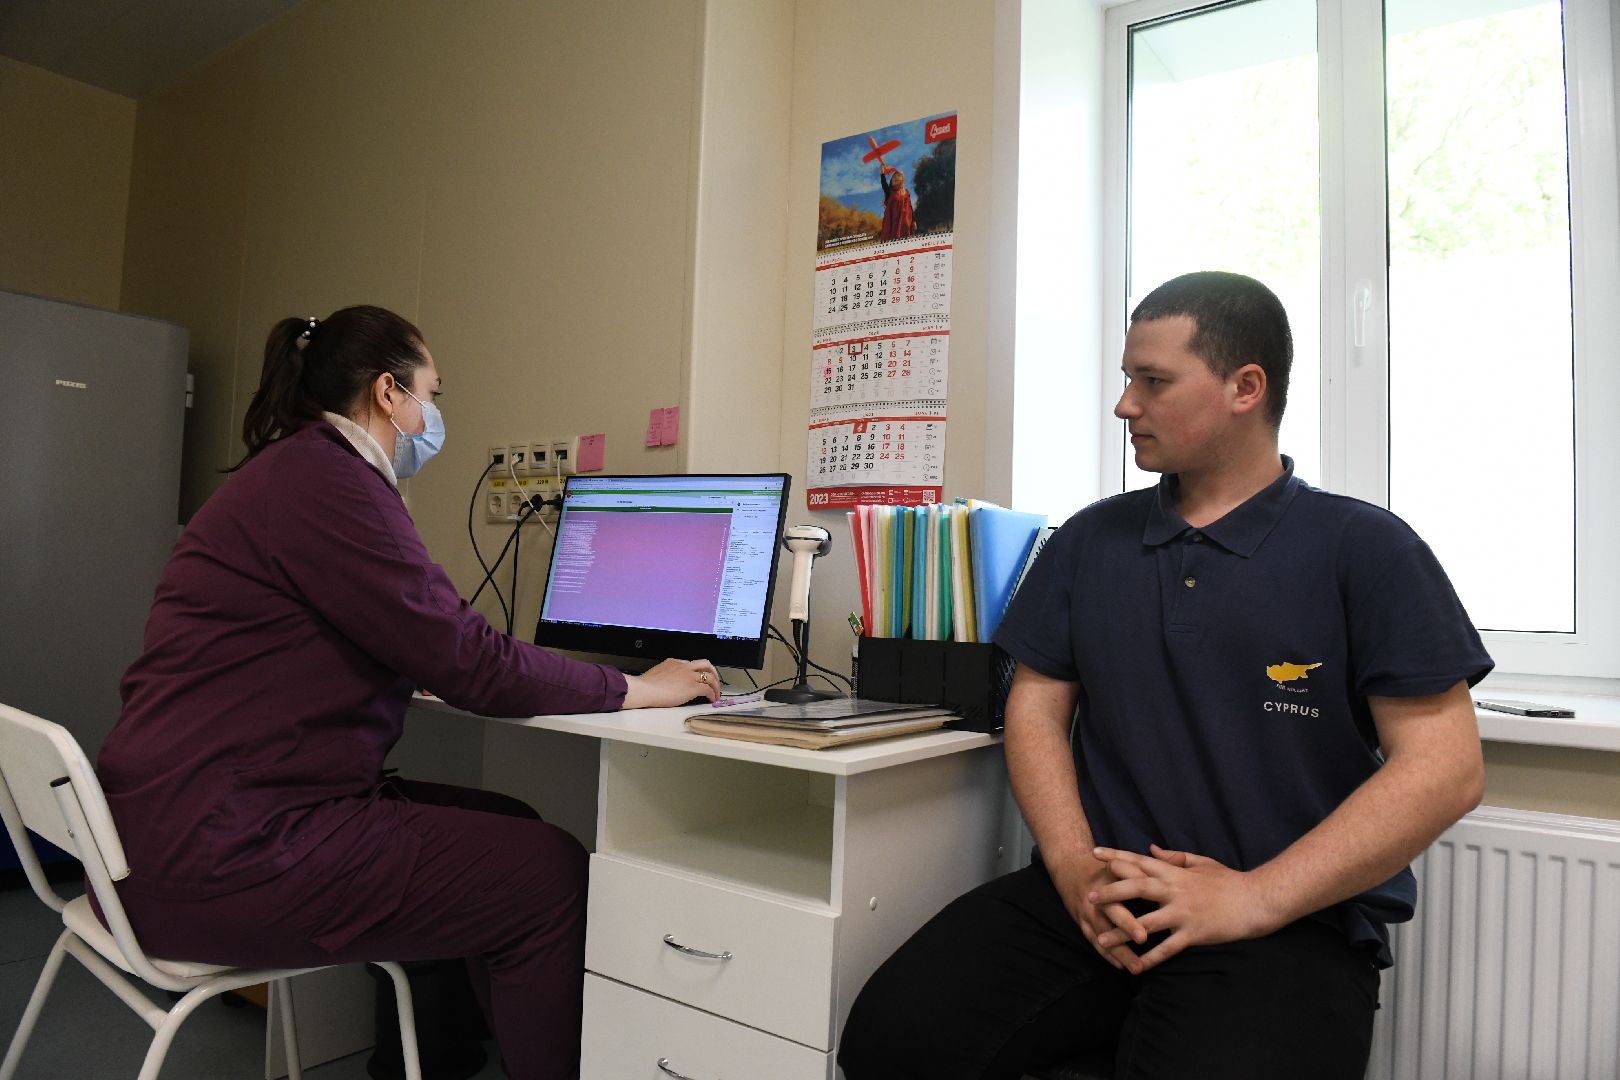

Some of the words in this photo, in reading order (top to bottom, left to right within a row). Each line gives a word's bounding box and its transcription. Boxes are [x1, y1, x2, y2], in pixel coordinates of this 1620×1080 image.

[842, 444, 849, 452] 14
[809, 493, 829, 505] 2023
[1263, 701, 1319, 718] CYPRUS
